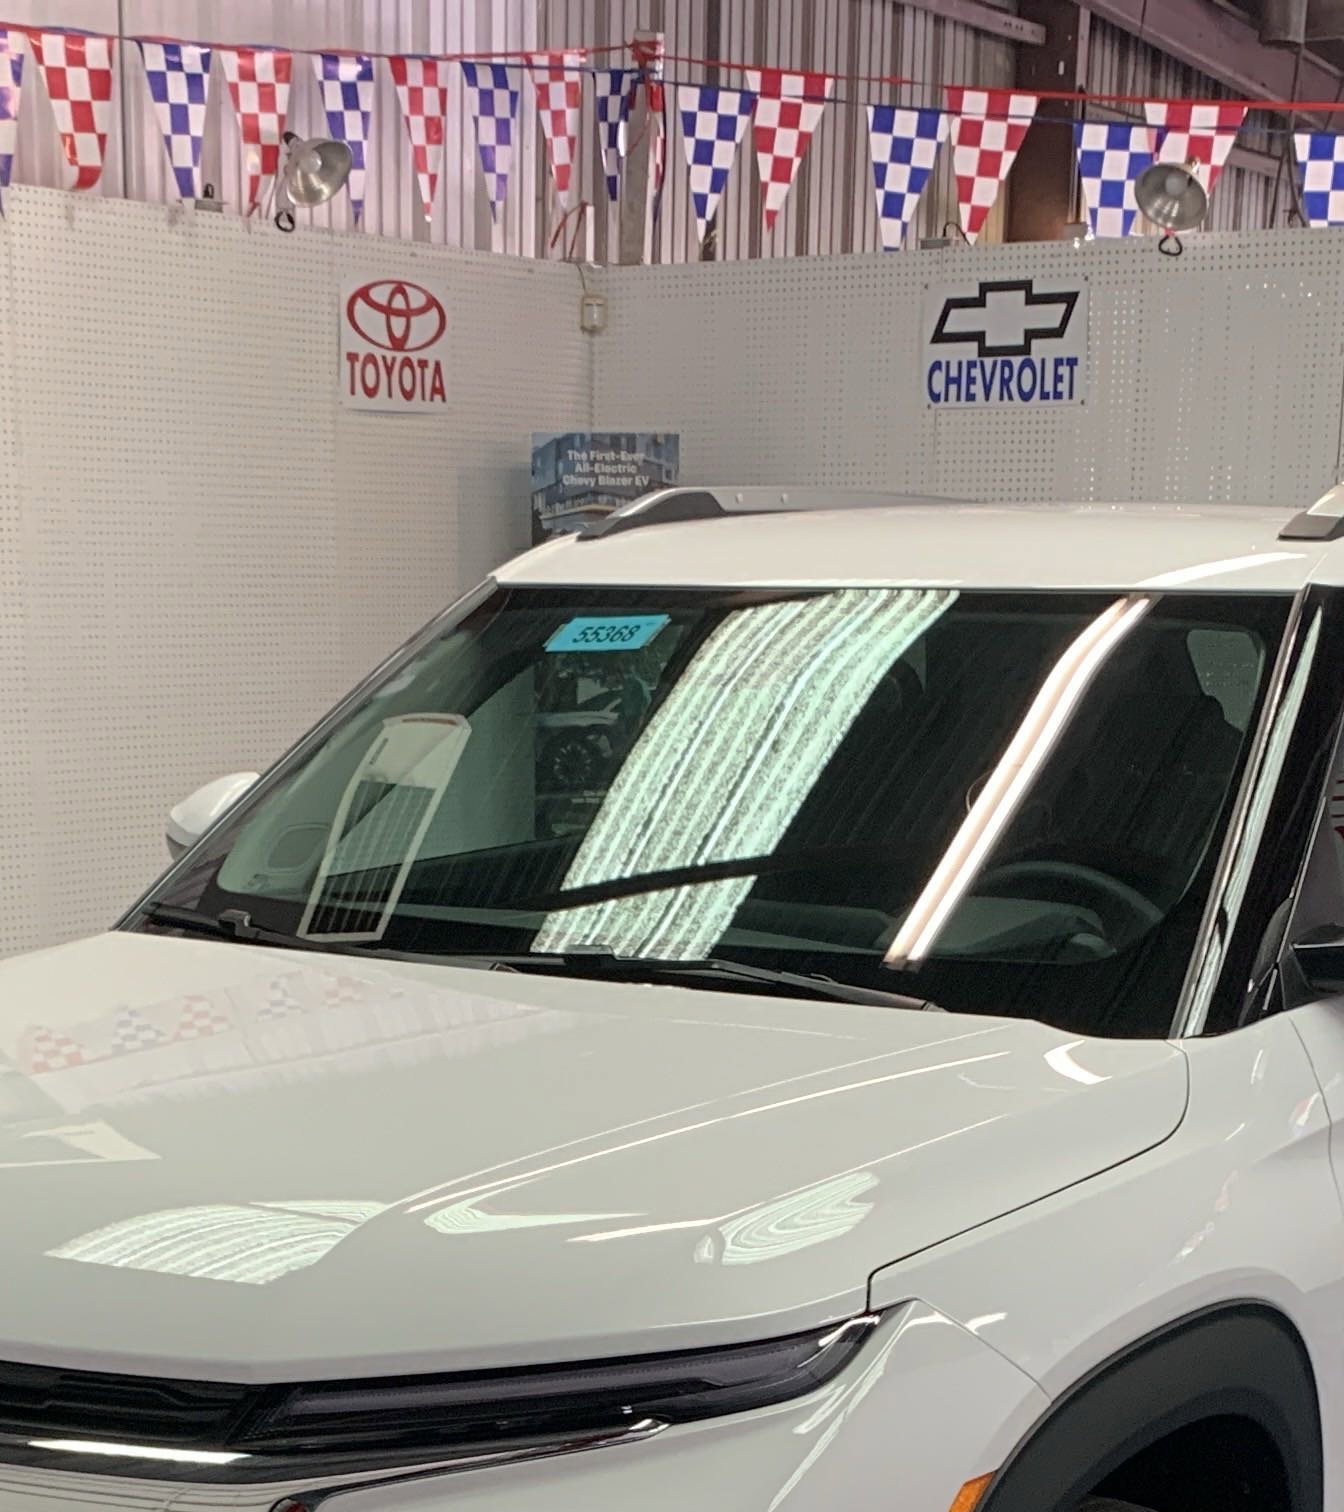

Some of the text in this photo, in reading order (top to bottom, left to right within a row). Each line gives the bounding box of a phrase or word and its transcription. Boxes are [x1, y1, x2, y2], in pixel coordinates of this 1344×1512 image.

[346, 352, 447, 403] TOYOTA
[927, 357, 1078, 404] CHEVROLET
[567, 450, 588, 461] The
[635, 476, 650, 486] EV
[572, 625, 641, 643] 55368
